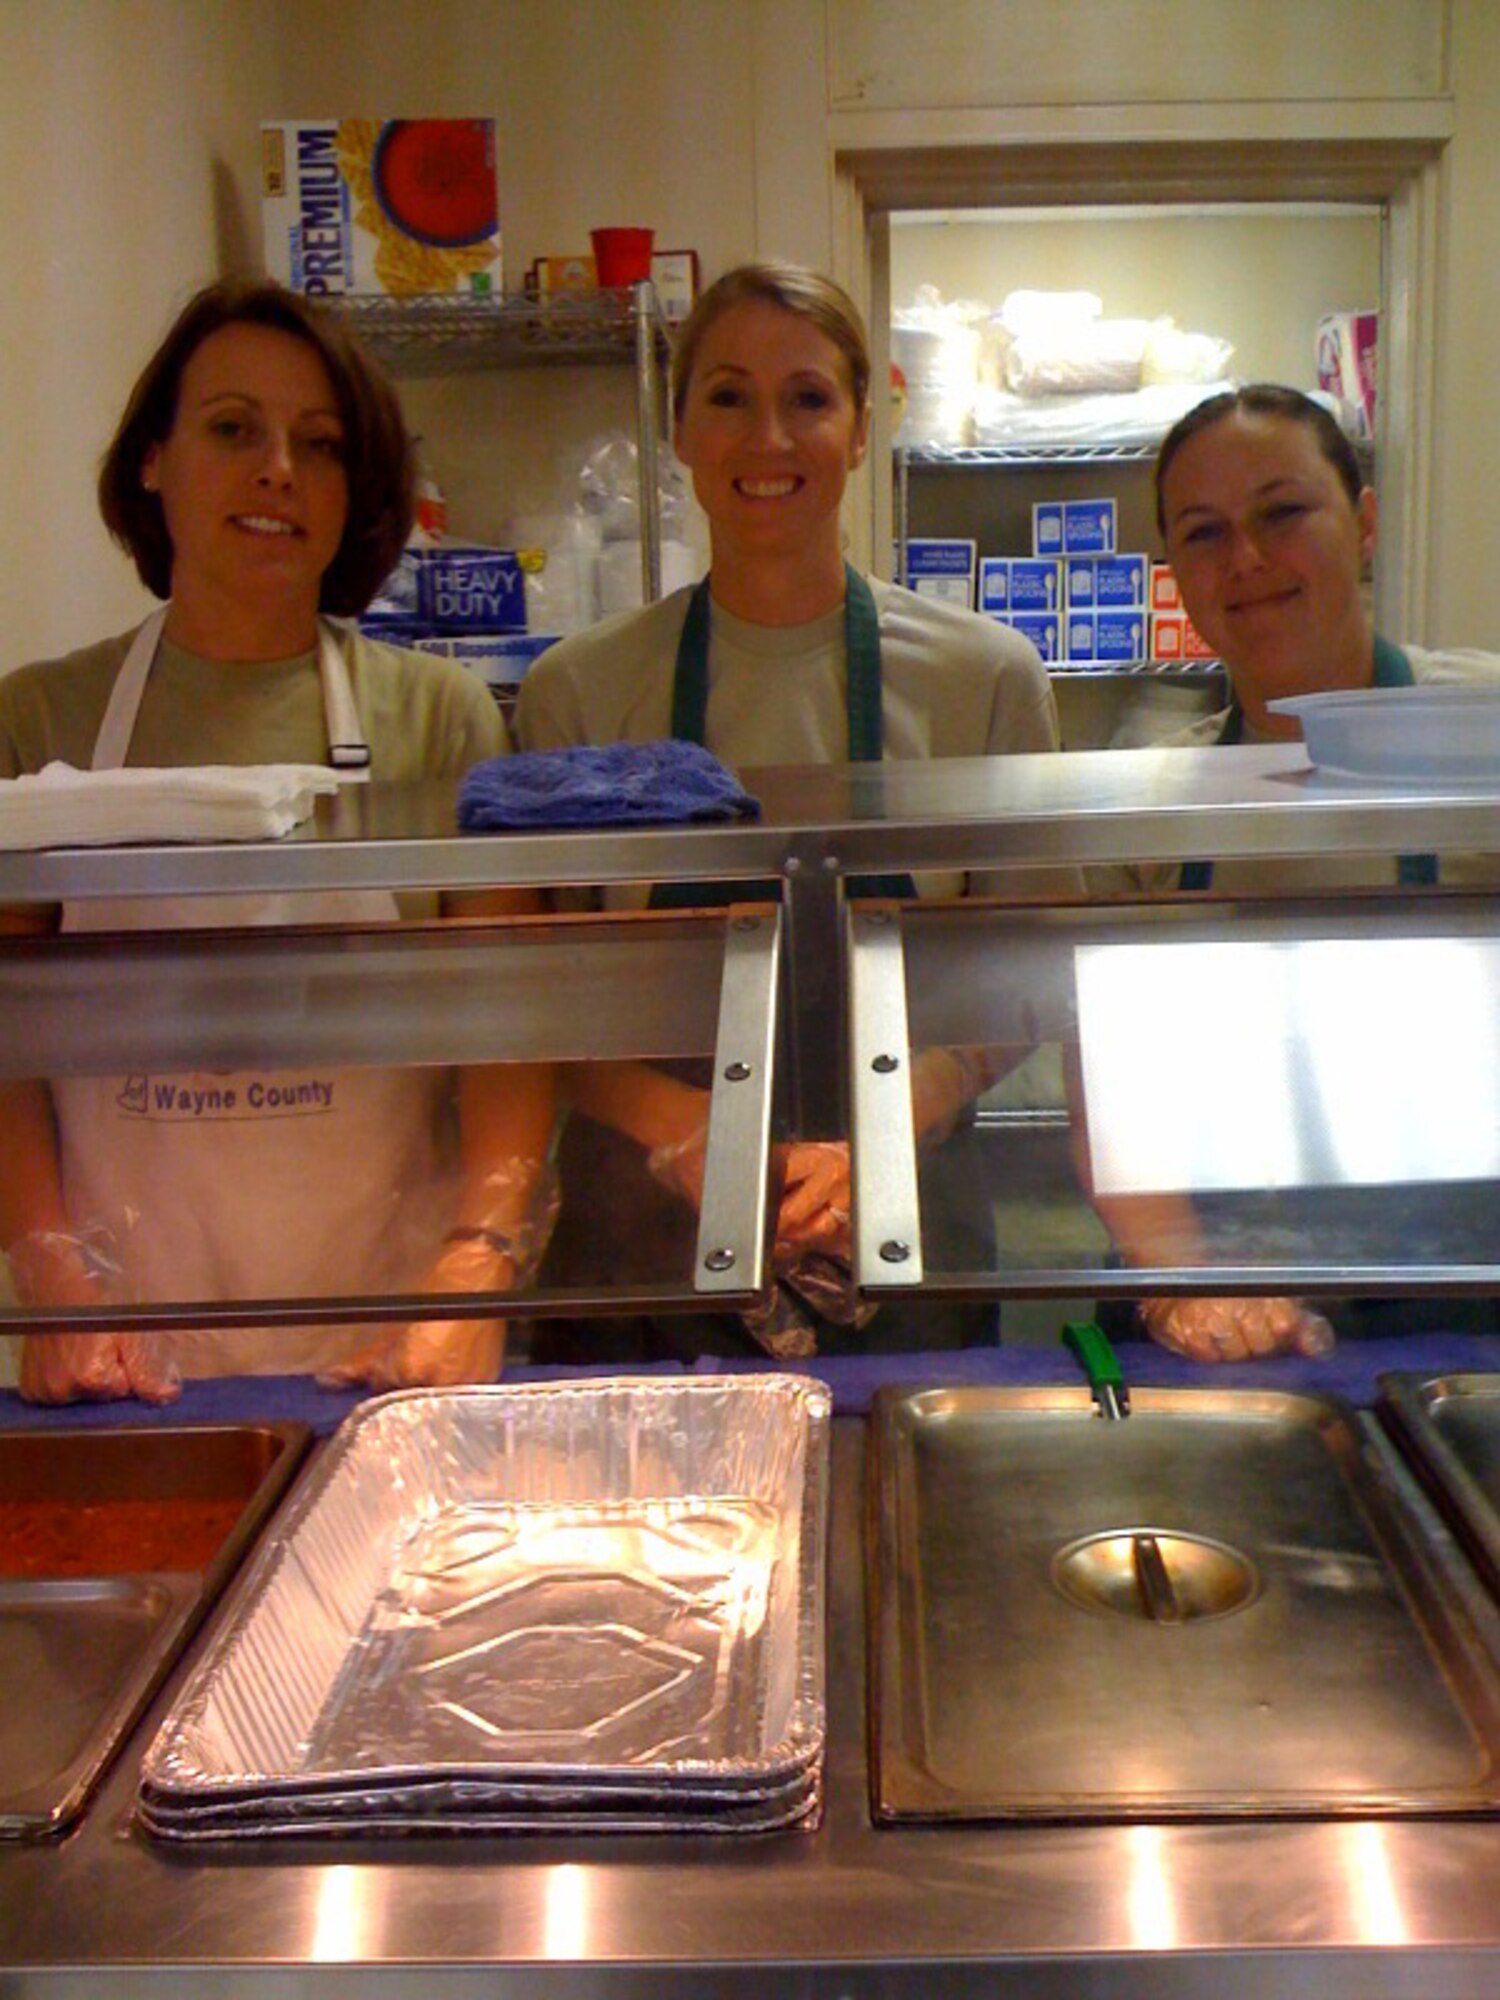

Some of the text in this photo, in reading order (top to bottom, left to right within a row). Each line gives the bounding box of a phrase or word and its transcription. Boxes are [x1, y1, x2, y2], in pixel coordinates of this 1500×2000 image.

[298, 129, 344, 297] PREMIUM
[434, 569, 518, 592] HEAVY
[436, 592, 503, 616] DUTY
[154, 1080, 334, 1115] Wayne County
